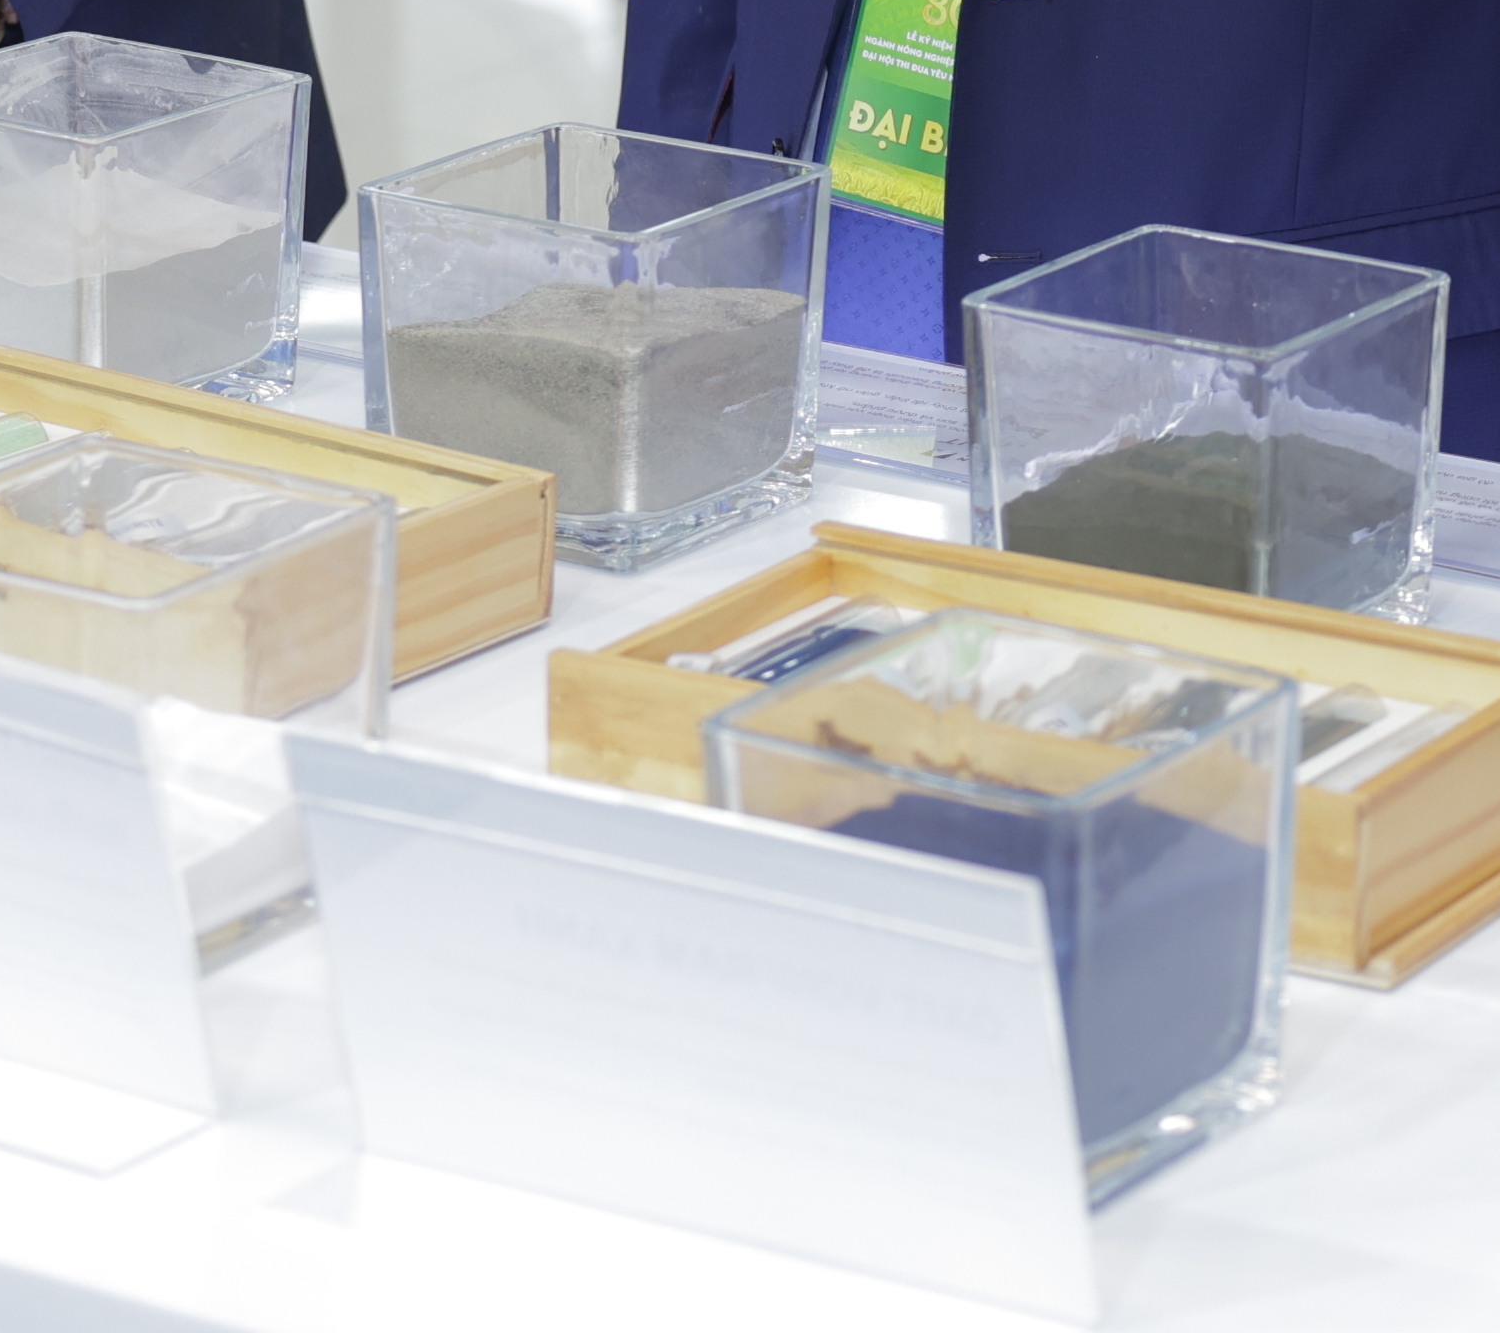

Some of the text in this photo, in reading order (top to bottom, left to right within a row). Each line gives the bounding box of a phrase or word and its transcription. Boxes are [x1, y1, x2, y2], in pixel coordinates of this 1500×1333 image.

[864, 35, 895, 50] NGÀNH
[896, 44, 923, 57] NÔNG
[906, 31, 953, 51] LỄ KỶ NIỆM
[862, 49, 947, 80] ĐẠI HỘI THI ĐUA YÊU
[848, 99, 913, 150] ĐẠI
